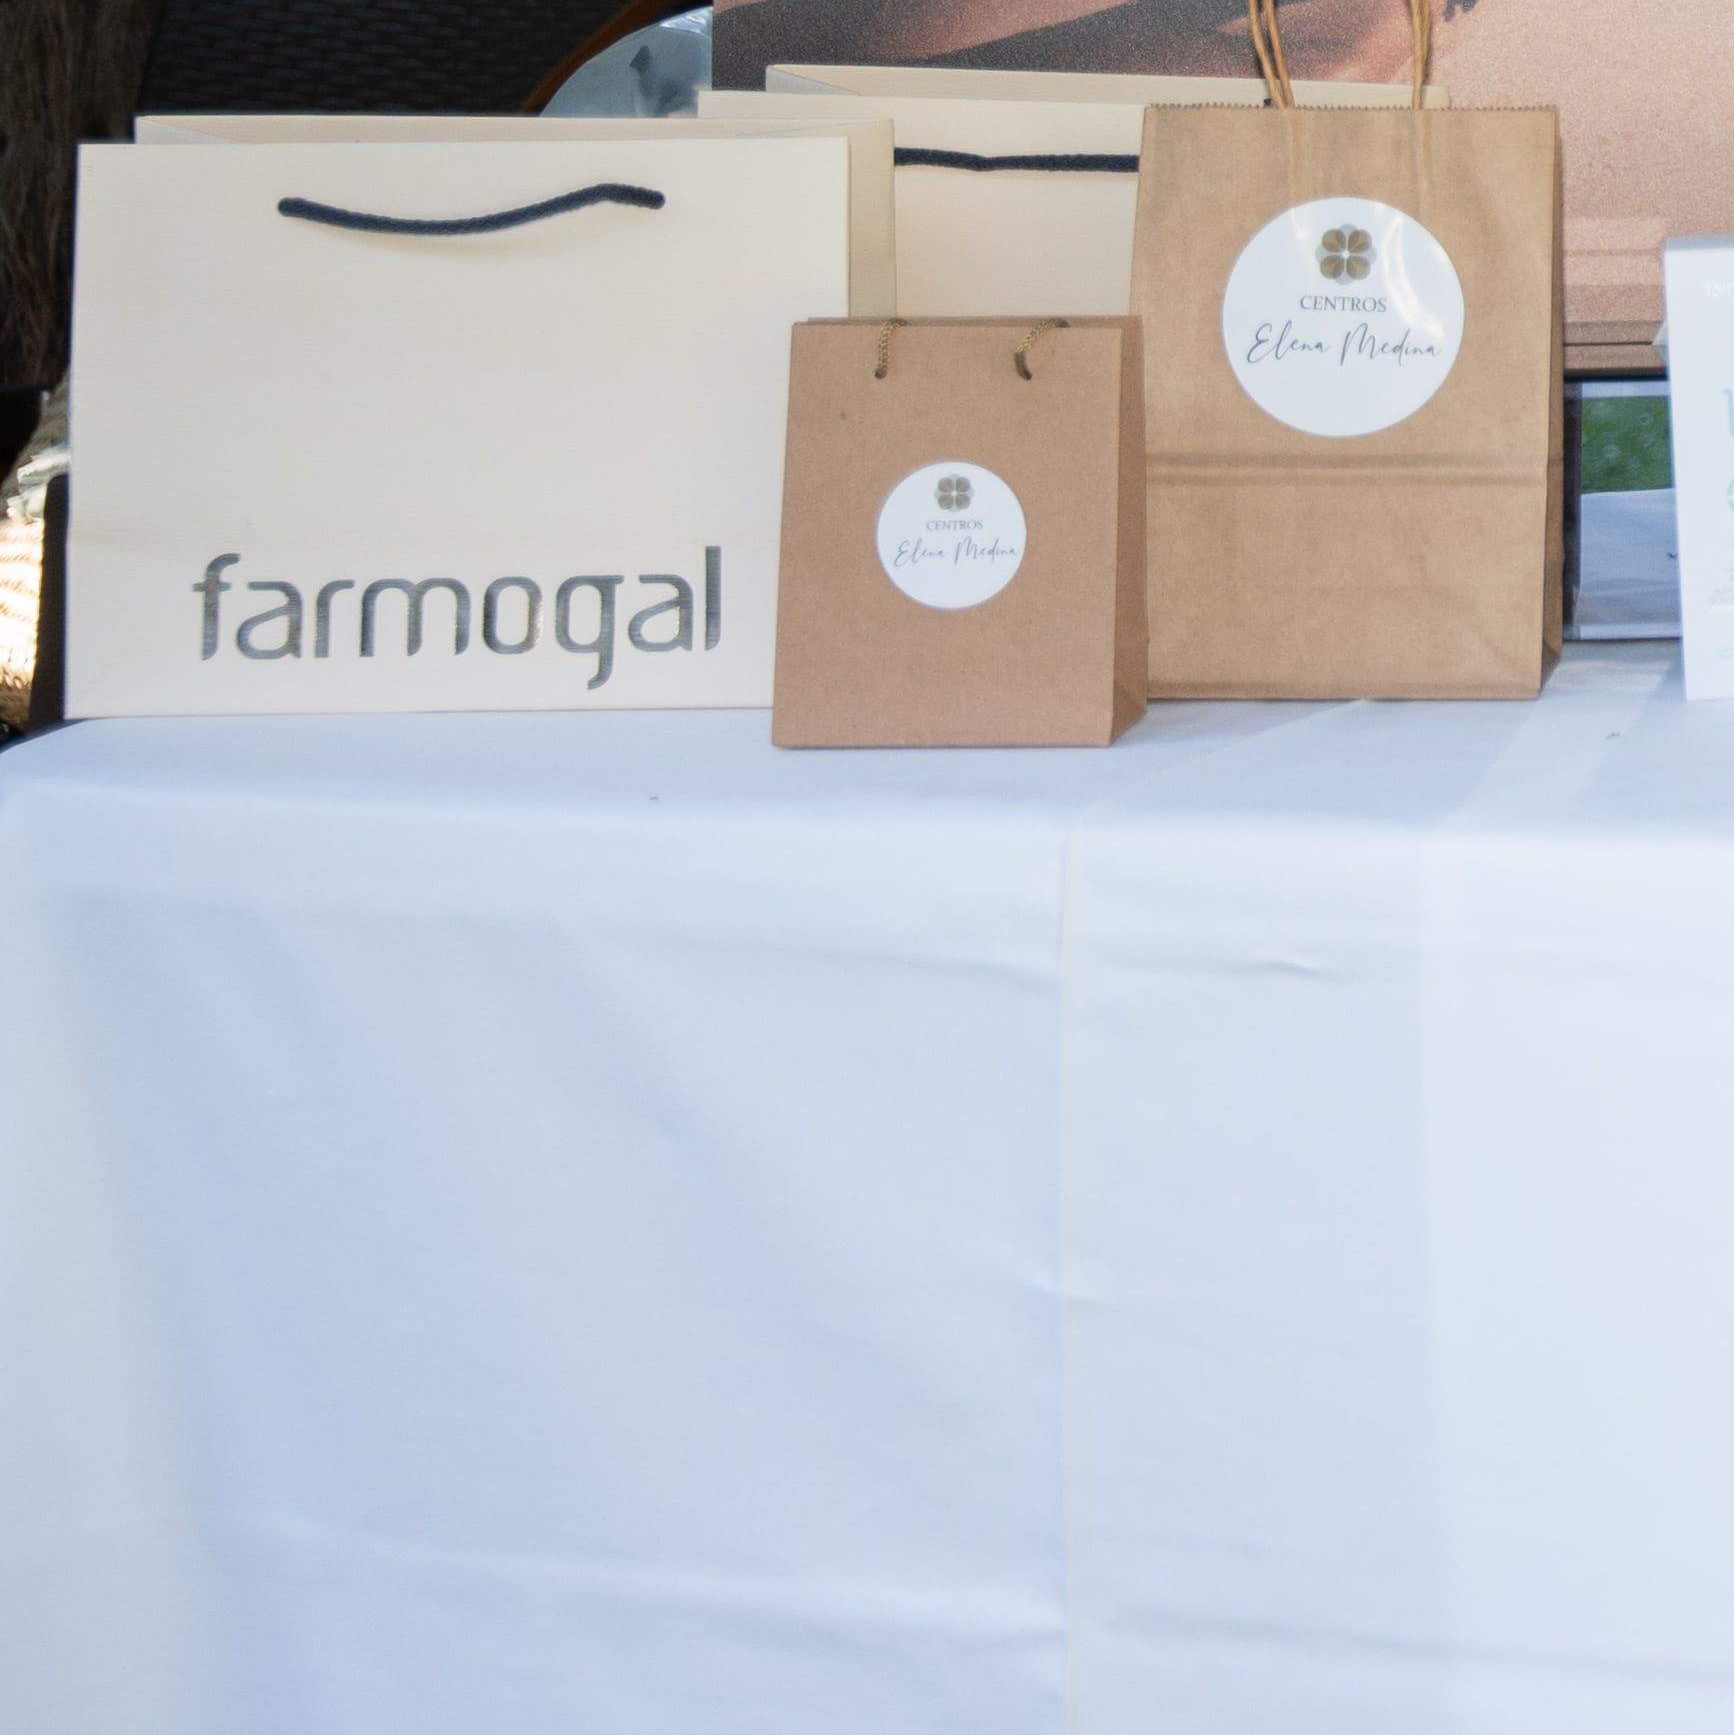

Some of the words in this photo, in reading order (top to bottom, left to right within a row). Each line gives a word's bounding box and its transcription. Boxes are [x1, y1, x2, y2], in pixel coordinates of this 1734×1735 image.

[1299, 294, 1388, 313] CENTROS
[1245, 319, 1330, 365] Elena
[1339, 321, 1441, 367] Medina
[926, 519, 984, 532] CENTROS
[893, 536, 947, 568] Elena
[953, 535, 1018, 565] Medina
[192, 545, 722, 690] farmogal
